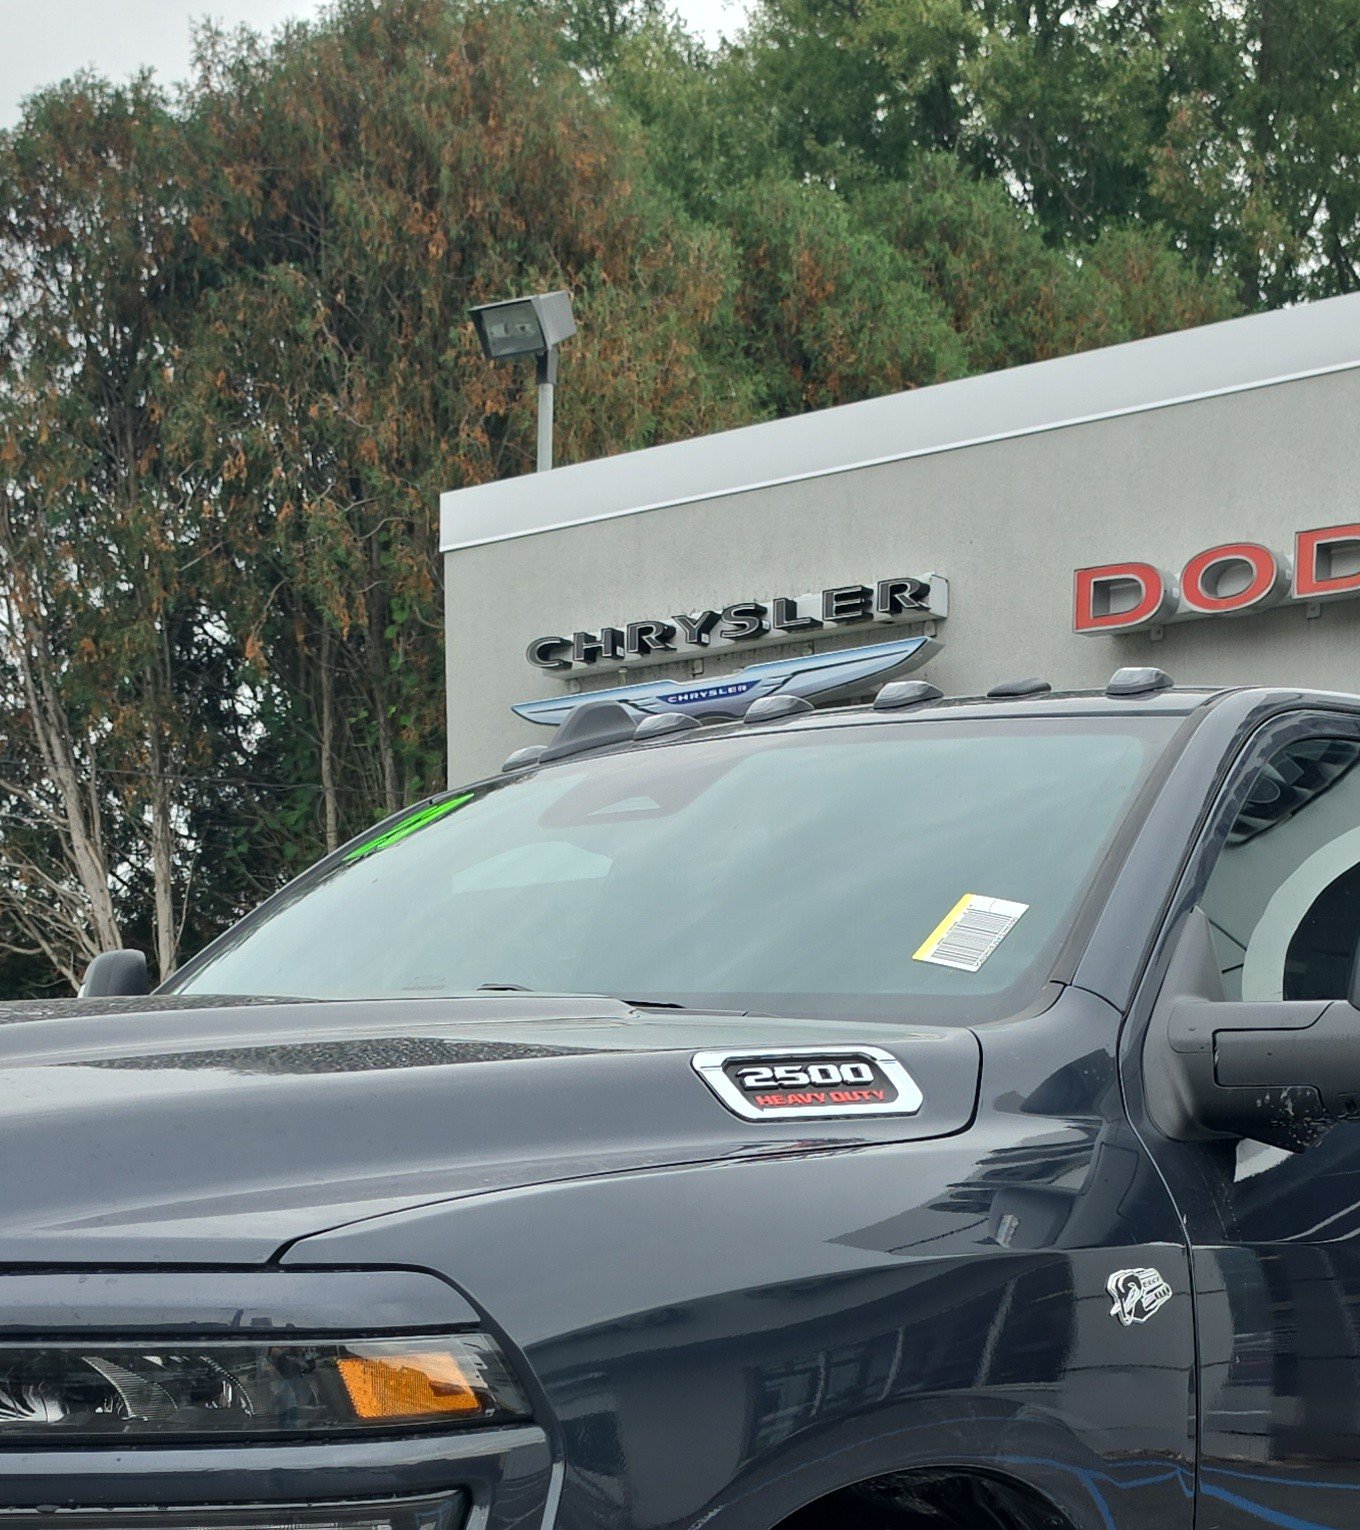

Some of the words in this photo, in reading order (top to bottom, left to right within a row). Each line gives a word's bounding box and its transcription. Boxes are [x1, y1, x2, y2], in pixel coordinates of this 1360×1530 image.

[526, 576, 932, 669] CHRYSLER
[738, 1062, 875, 1090] 2500
[754, 1092, 828, 1107] HEAVY
[828, 1089, 885, 1103] DUTY
